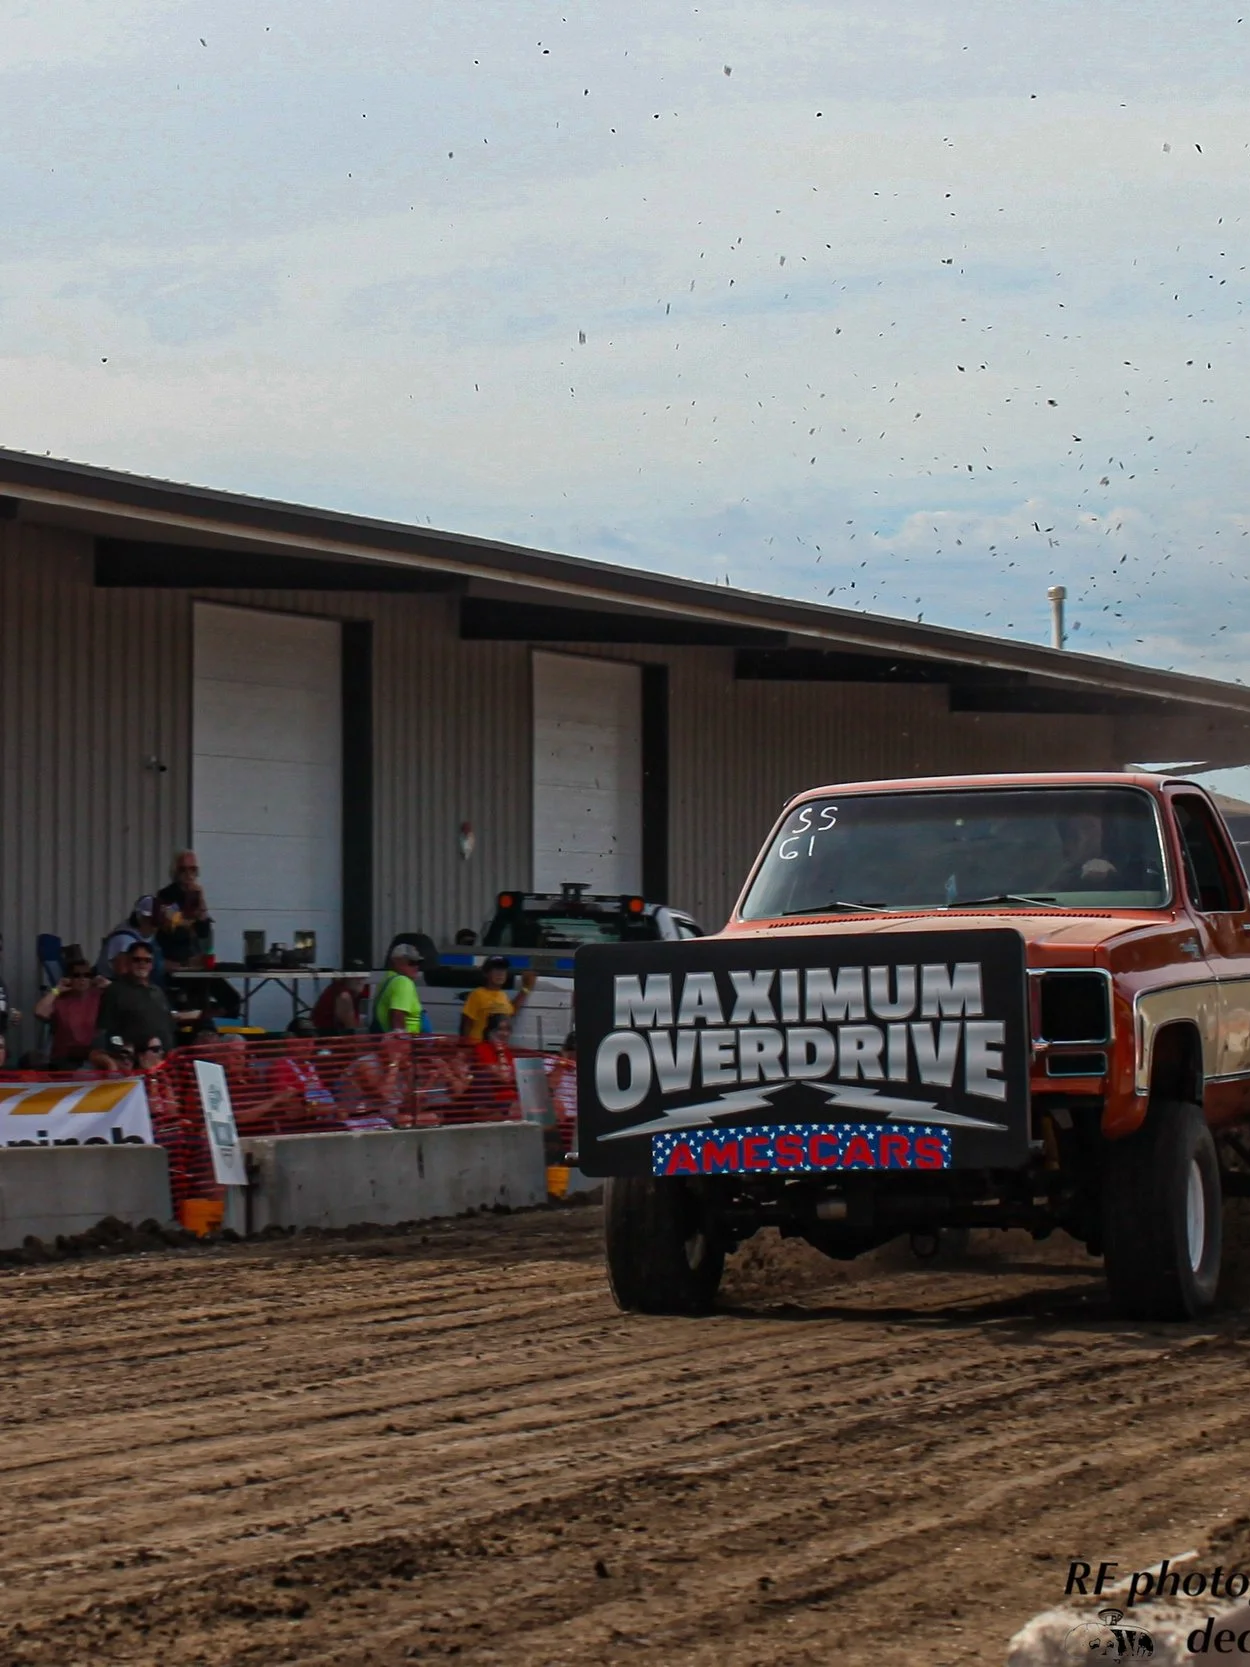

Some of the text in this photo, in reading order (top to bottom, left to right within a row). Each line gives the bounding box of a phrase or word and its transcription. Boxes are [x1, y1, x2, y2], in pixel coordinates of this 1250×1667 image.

[779, 835, 816, 860] 61
[613, 961, 985, 1028] MAXIMUM
[594, 1020, 1007, 1113] OVERDRIVE
[664, 1133, 945, 1177] AMESCARS
